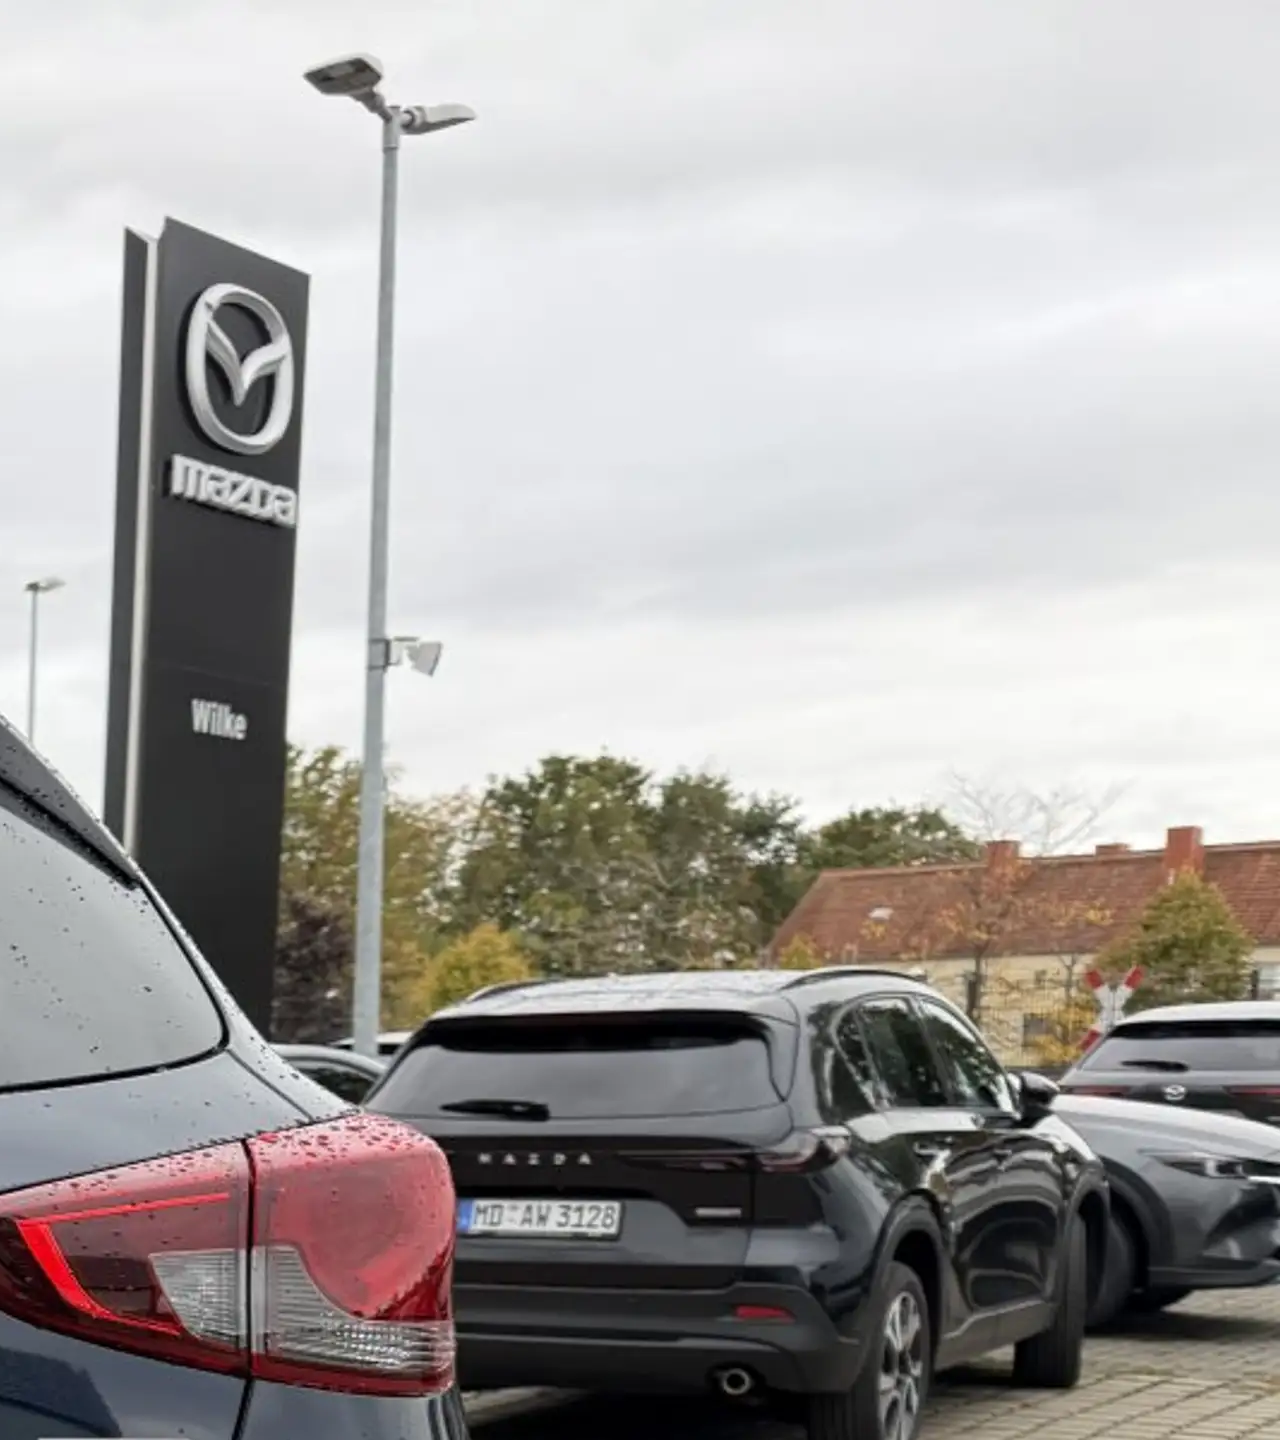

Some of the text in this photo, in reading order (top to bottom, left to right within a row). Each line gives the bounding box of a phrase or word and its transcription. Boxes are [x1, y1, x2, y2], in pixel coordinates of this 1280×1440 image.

[191, 699, 247, 740] Wilke
[478, 1153, 592, 1165] MAZDA
[555, 1205, 618, 1229] 3128
